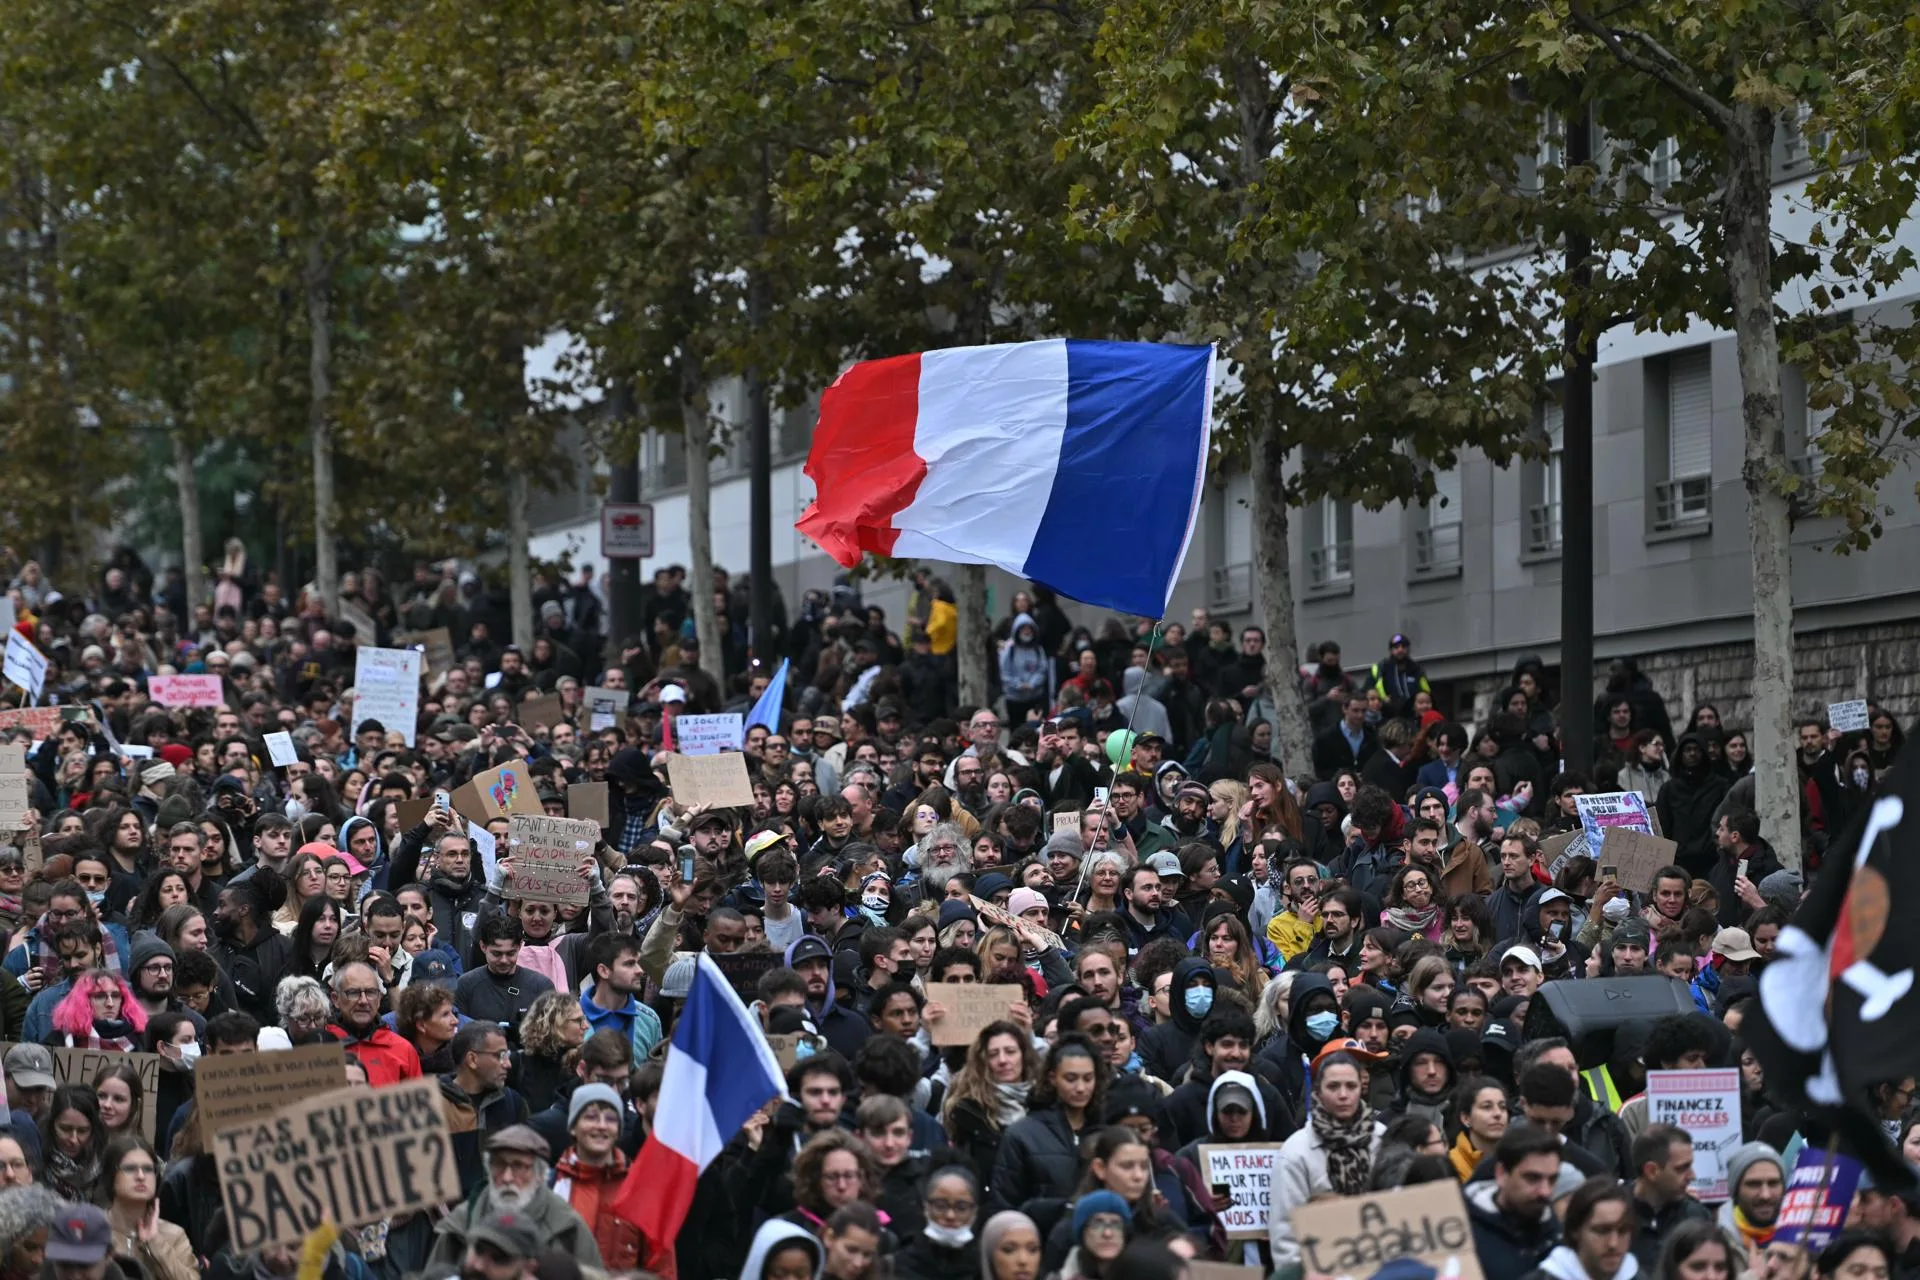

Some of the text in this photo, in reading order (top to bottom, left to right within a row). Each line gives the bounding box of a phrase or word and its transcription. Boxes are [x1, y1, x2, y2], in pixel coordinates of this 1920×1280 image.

[514, 816, 544, 832] TANT
[547, 820, 560, 833] DE
[1656, 1098, 1724, 1111] FINANCEZ
[218, 1118, 292, 1151] T'AS
[355, 1087, 432, 1123] PEUR
[1679, 1111, 1729, 1125] ÉCOLES
[224, 1139, 308, 1175] QU'ON
[1212, 1154, 1274, 1170] MA FRANCE
[226, 1132, 446, 1249] BASTILLE?
[1225, 1210, 1255, 1225] NOUS
[1359, 1201, 1388, 1228] A
